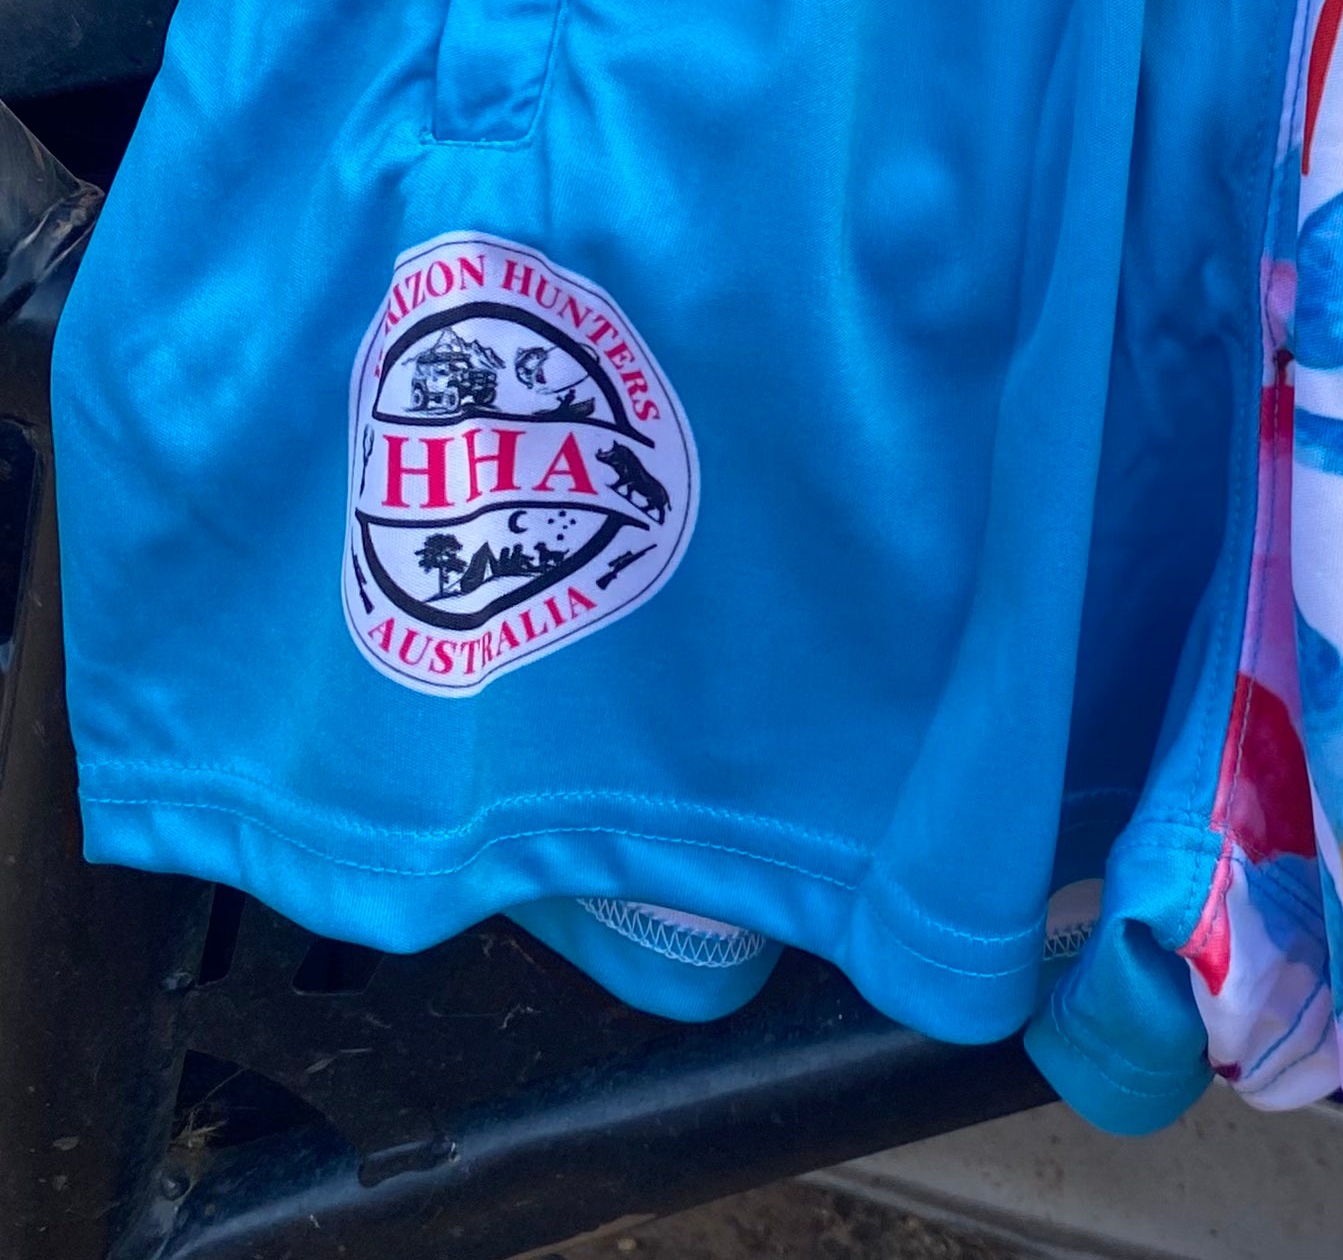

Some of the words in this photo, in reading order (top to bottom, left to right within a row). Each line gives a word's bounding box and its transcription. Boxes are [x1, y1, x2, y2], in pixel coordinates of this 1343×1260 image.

[502, 259, 661, 421] HUNTERS
[381, 428, 599, 509] HHA
[367, 586, 598, 675] AUSTRALIA
